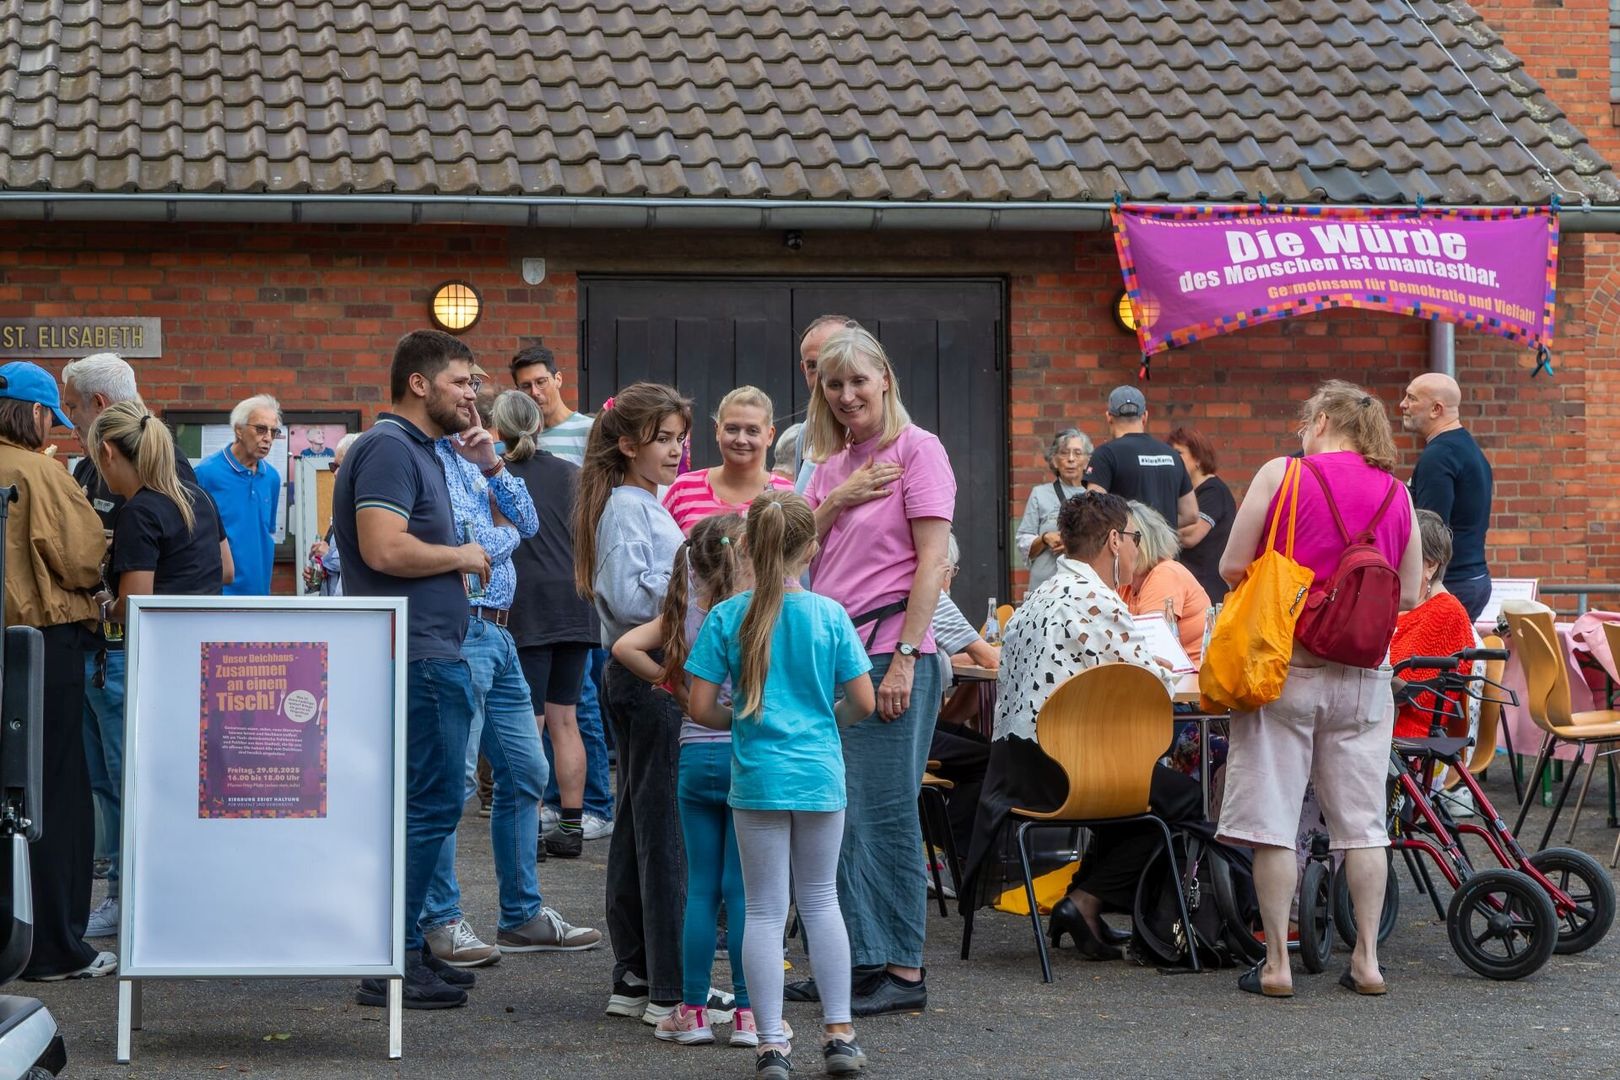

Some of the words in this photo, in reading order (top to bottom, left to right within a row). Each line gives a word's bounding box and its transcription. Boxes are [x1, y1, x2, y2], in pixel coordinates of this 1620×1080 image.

[1225, 229, 1305, 264] Die
[1309, 223, 1467, 261] Würde
[1179, 270, 1221, 293] des
[1223, 257, 1339, 285] Menschen
[1341, 254, 1373, 271] ist
[1375, 256, 1500, 288] unantastbar.
[1364, 277, 1386, 291] für
[1389, 279, 1466, 305] Demokratie
[1469, 294, 1492, 311] und
[1494, 298, 1536, 325] Vielfalt!
[2, 325, 29, 348] ST.
[38, 325, 144, 348] ELISABETH
[222, 655, 248, 664] Unser
[248, 653, 294, 663] Deichhaus
[215, 664, 287, 678] Zusammen
[227, 678, 244, 691] an
[246, 676, 287, 691] einem
[215, 690, 275, 712] Tisch!
